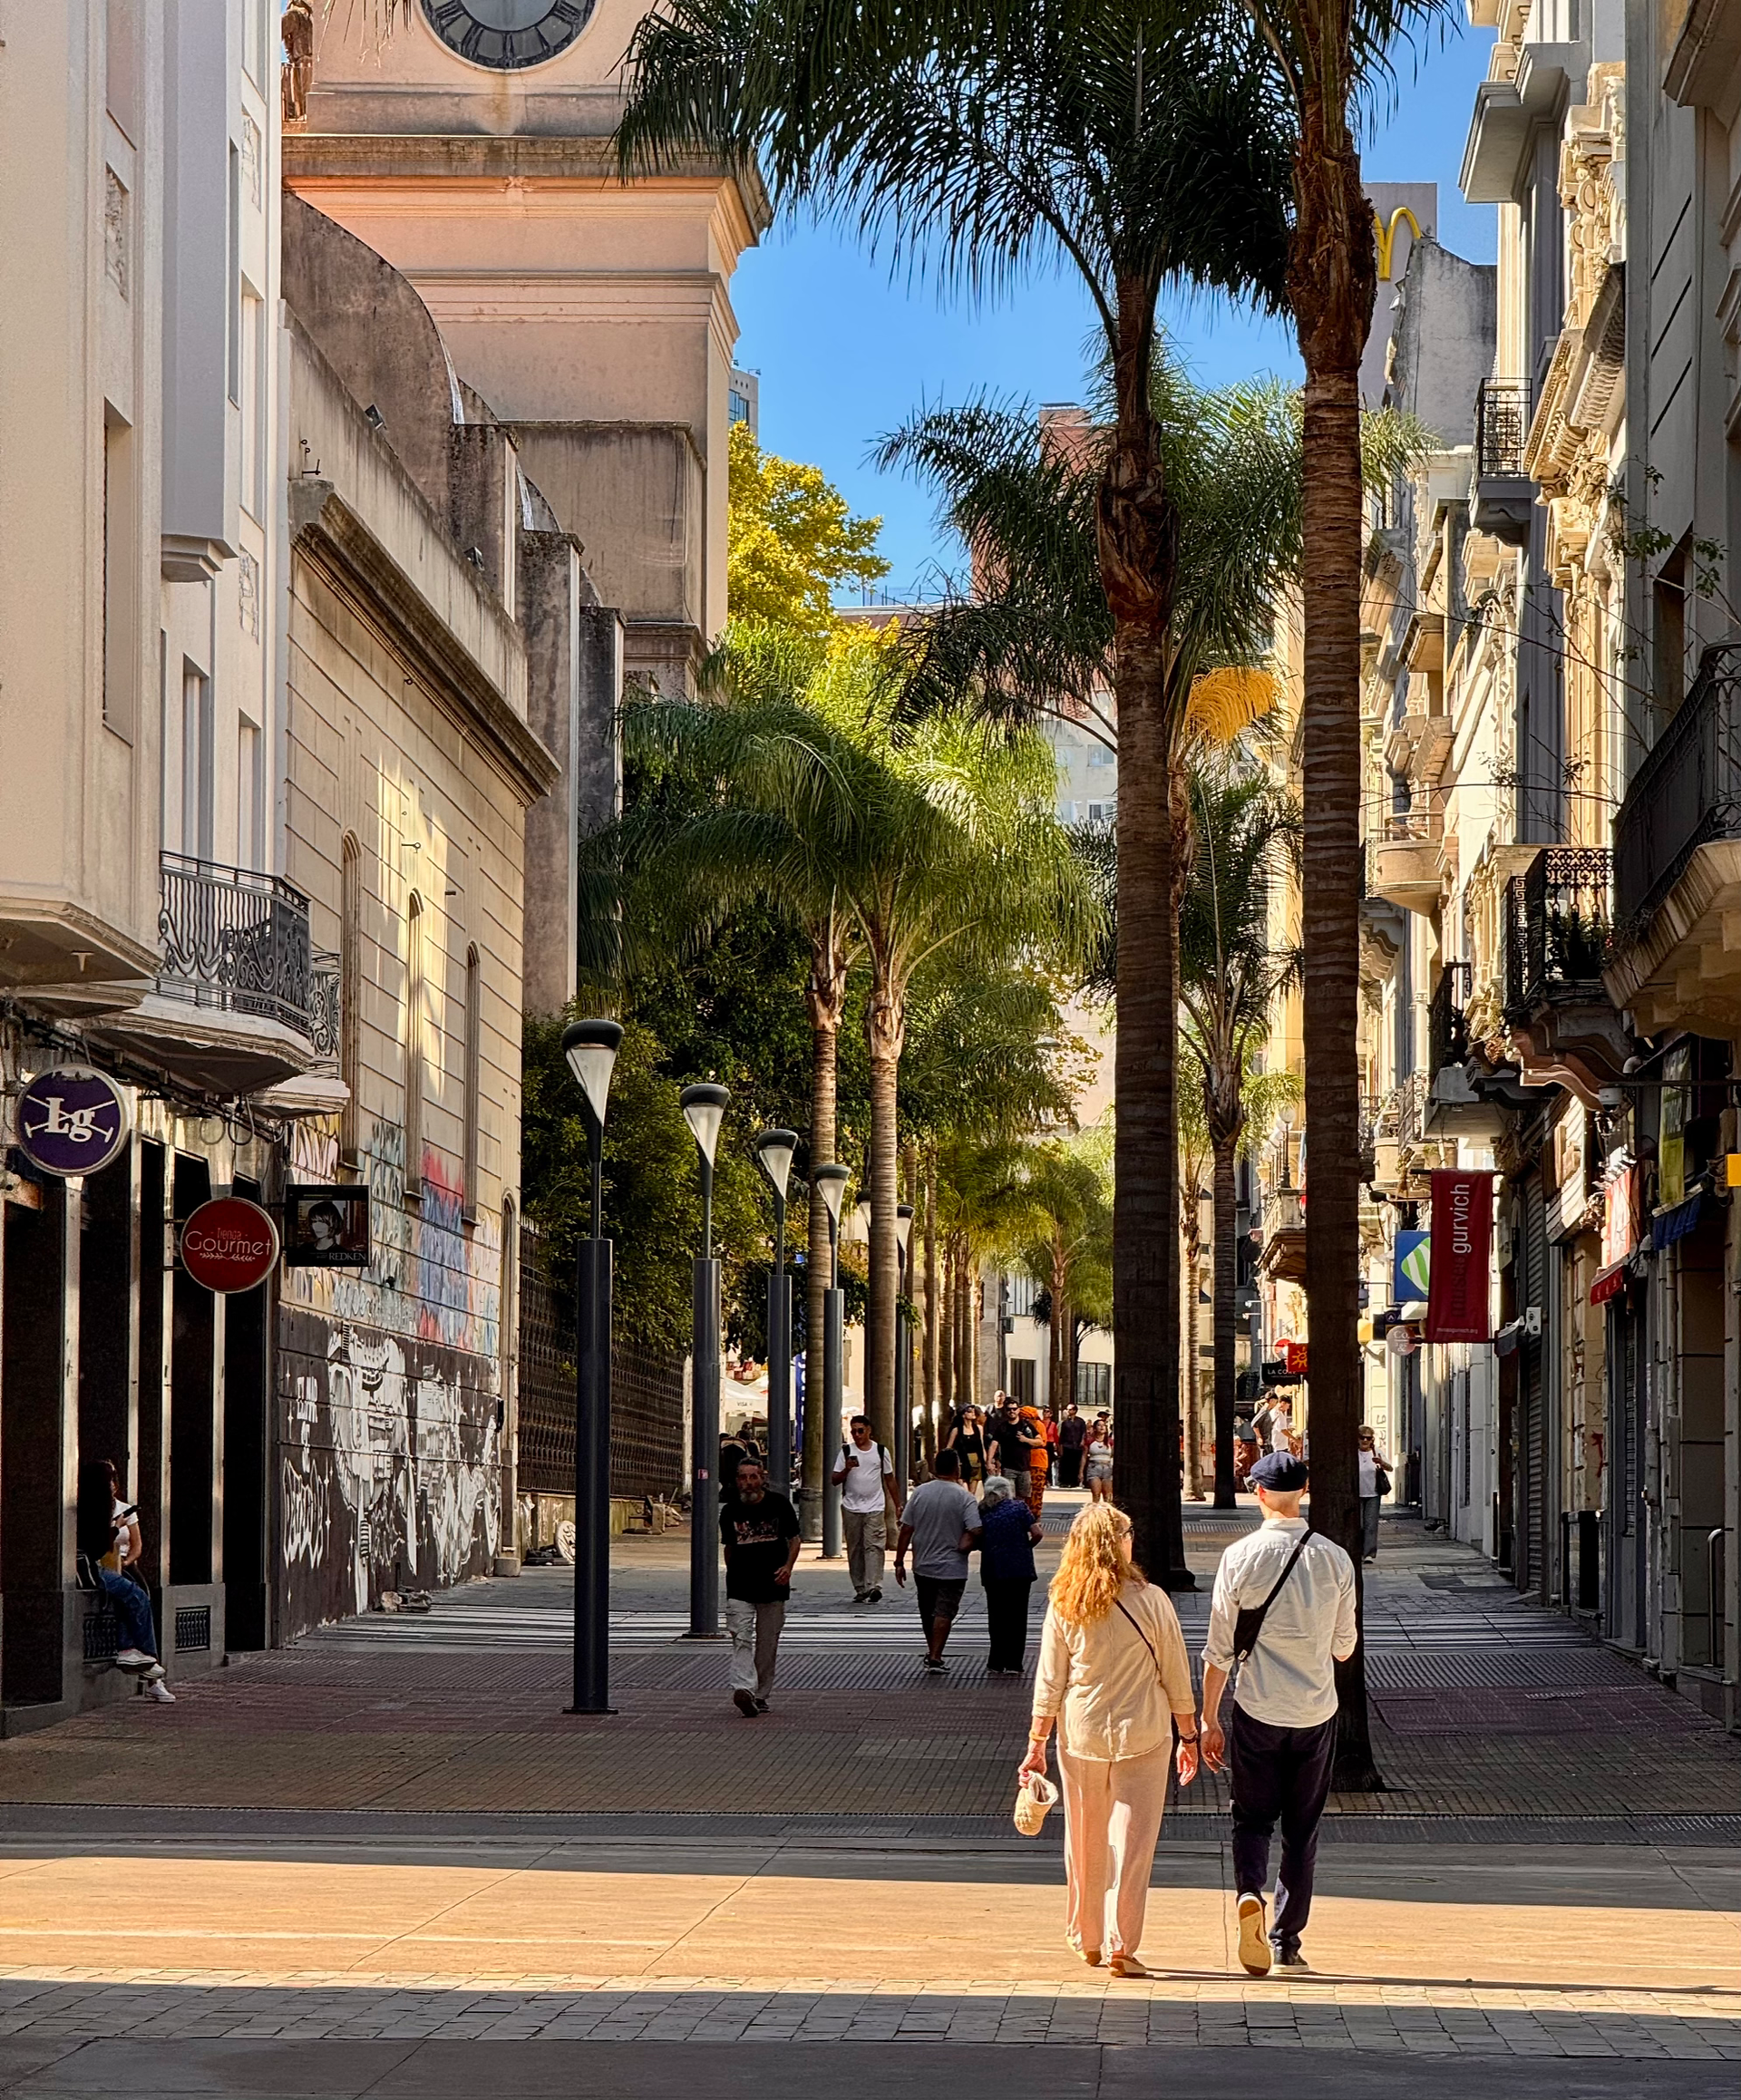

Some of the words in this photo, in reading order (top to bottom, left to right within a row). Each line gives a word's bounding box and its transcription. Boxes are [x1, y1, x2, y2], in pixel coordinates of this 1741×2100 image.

[44, 1097, 95, 1142] Lg
[185, 1230, 271, 1256] Gourmet
[328, 1251, 366, 1261] REDKEN
